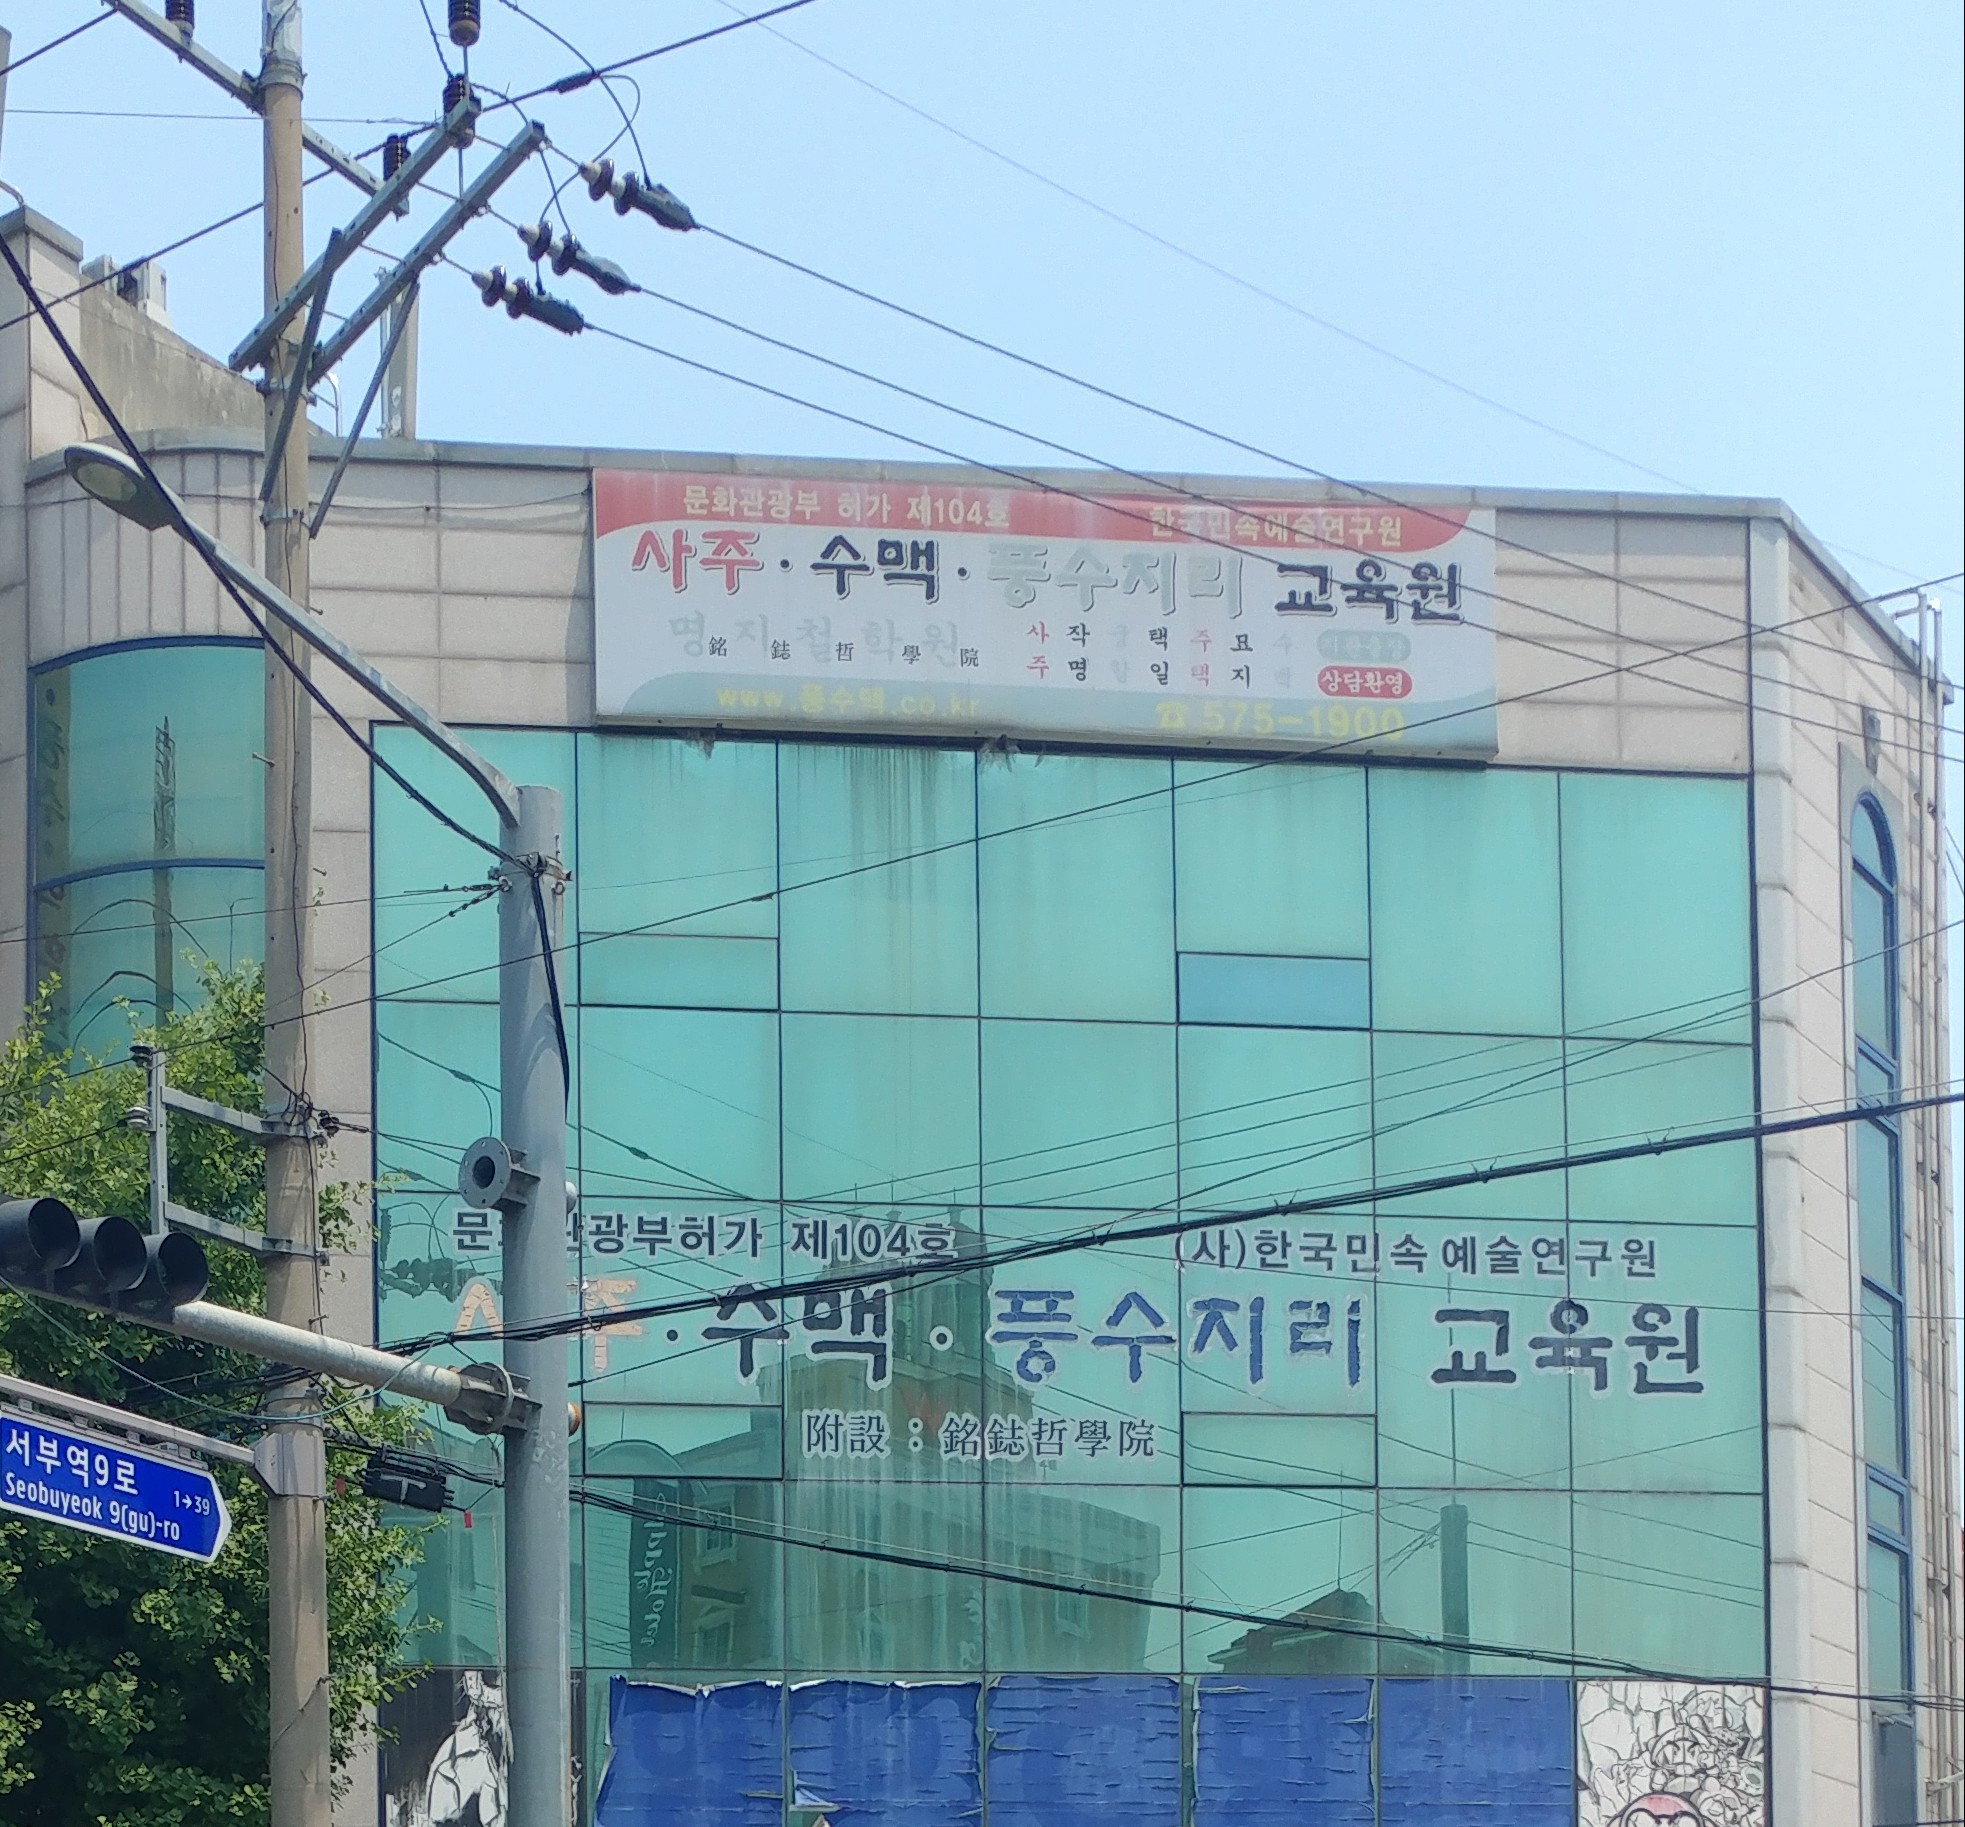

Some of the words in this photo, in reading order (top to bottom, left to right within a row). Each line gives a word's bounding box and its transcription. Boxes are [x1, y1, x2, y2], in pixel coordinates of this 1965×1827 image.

[683, 485, 820, 522] 문화관광부
[838, 491, 891, 524] 허가
[906, 494, 1010, 529] 제104호
[1149, 506, 1402, 547] 한국민속예술연구원
[631, 529, 764, 594] 사주
[809, 534, 941, 604] 수맥
[987, 541, 1243, 618] 풍수지리
[1274, 557, 1466, 626] 교육원
[1067, 623, 1091, 684] 작명
[1148, 626, 1169, 686] 택일
[1230, 633, 1254, 689] 묘지
[1321, 669, 1403, 695] 상담환영
[1201, 702, 1405, 740] 575-1900
[452, 1212, 763, 1258] 문광부허가
[790, 1217, 956, 1261] 제104호
[991, 1289, 1361, 1388] 풍수지리
[1430, 1300, 1705, 1395] 교육원
[5, 1427, 139, 1497] 서부역9로
[5, 1472, 103, 1520] Seobuyeok
[109, 1502, 181, 1542] 9(gu)-ro
